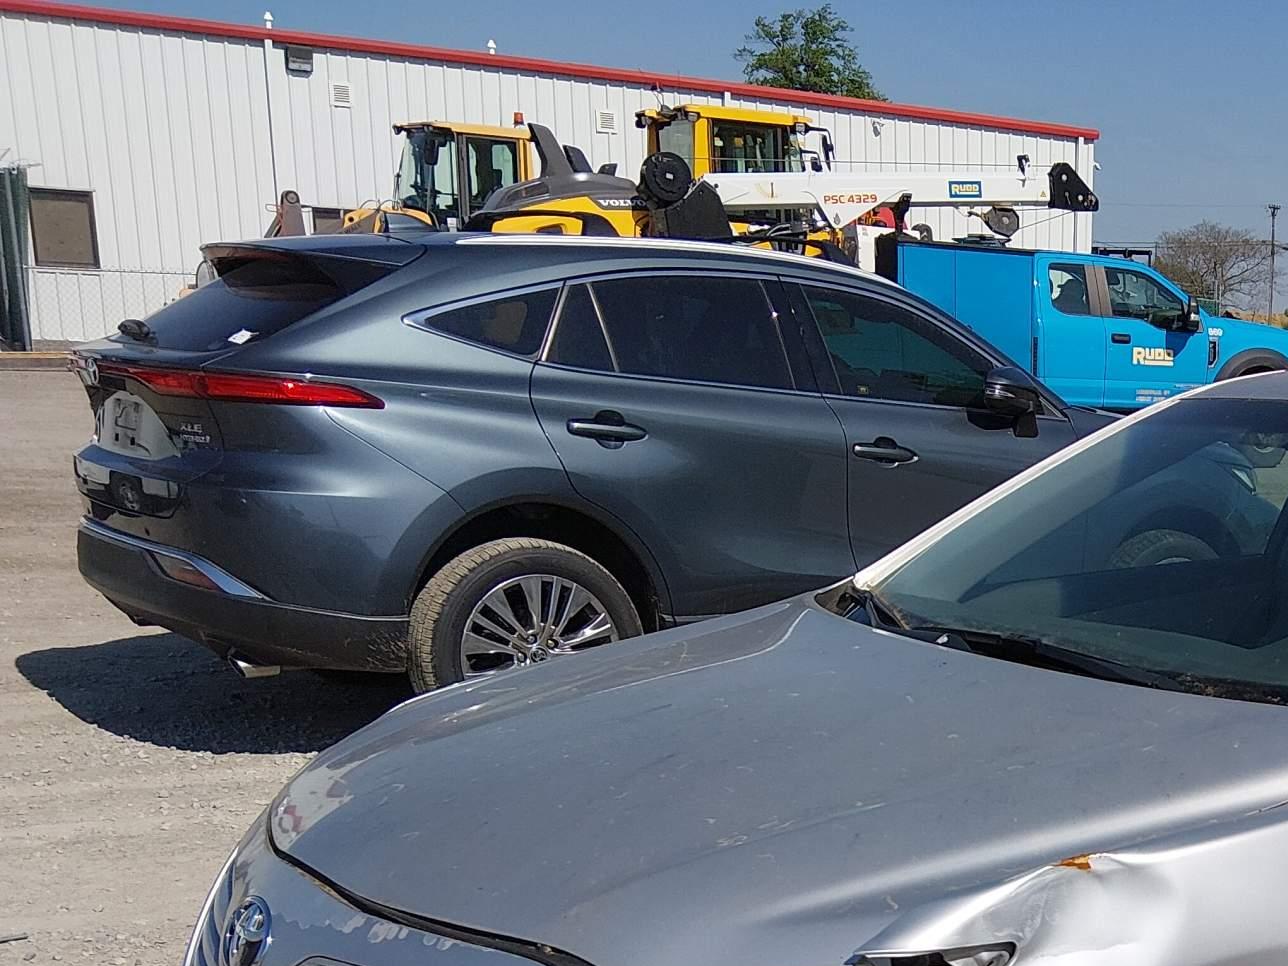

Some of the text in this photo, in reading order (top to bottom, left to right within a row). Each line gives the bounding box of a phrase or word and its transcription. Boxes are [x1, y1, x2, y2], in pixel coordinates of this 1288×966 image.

[951, 183, 980, 195] RUDD
[598, 199, 646, 207] VOLVO
[823, 193, 878, 204] PSC 4329
[1132, 346, 1174, 366] RUDD
